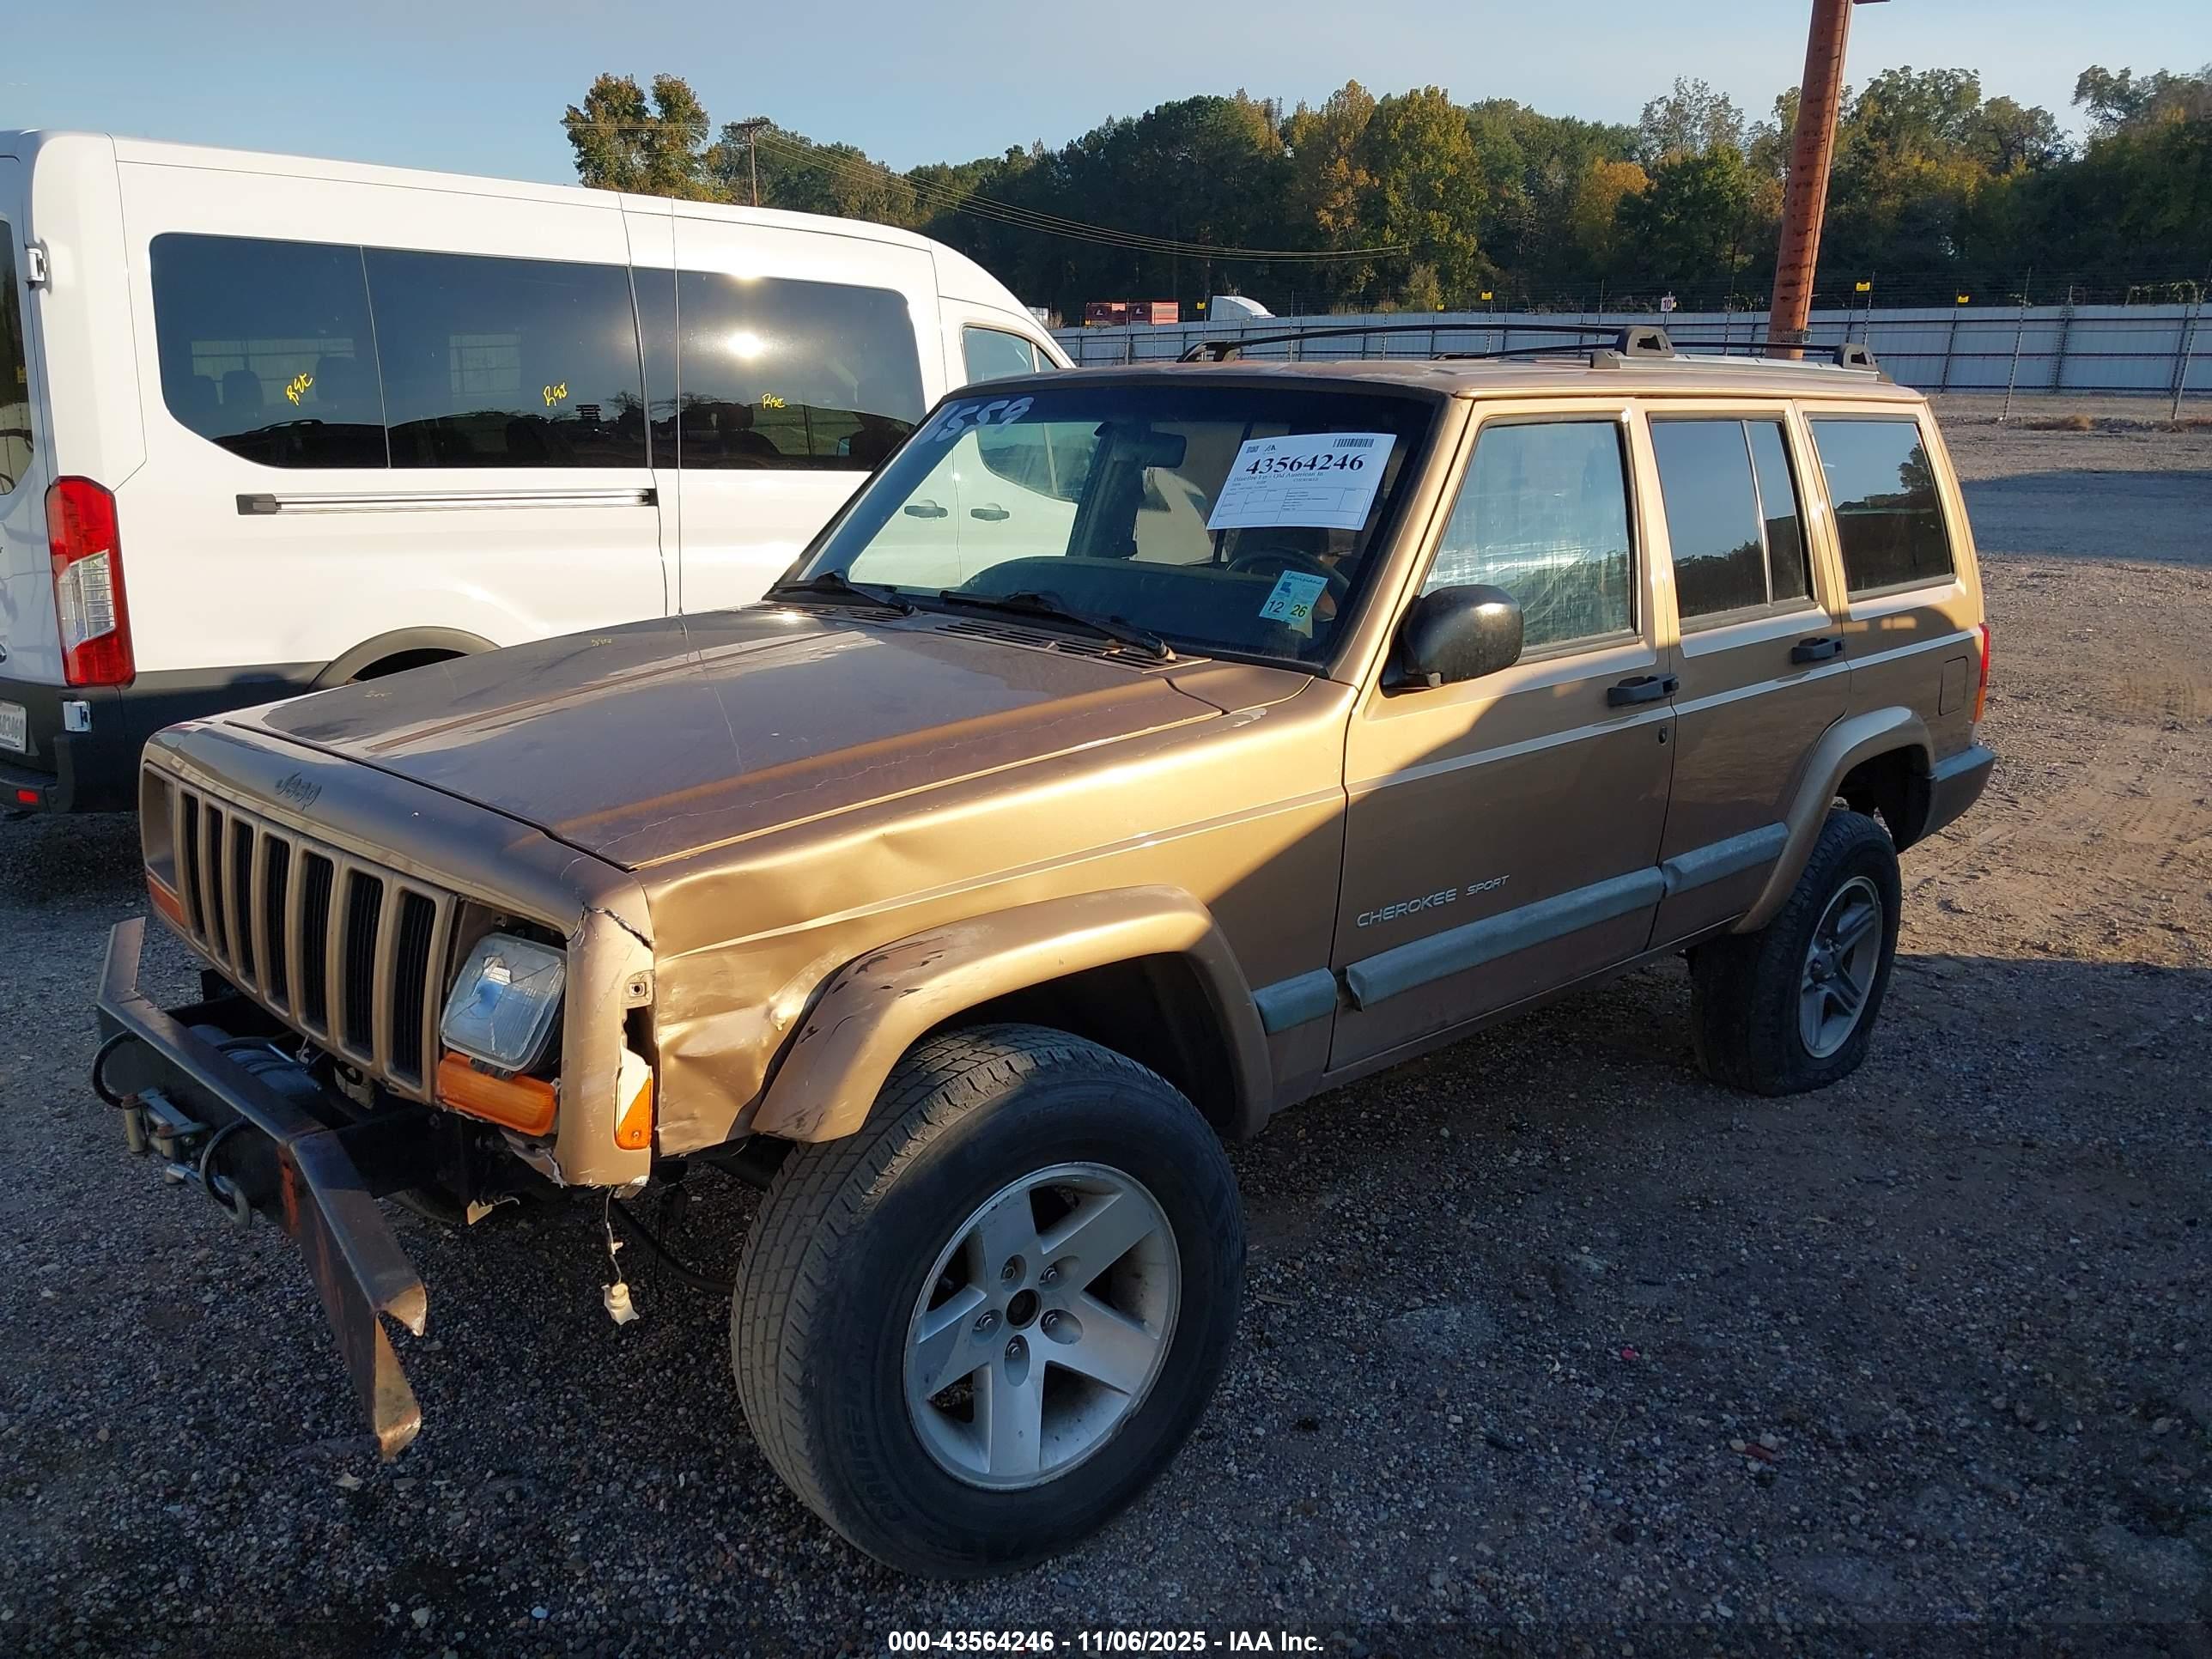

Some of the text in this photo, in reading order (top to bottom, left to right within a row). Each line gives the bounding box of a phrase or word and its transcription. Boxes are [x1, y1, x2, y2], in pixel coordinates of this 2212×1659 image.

[1245, 453, 1367, 474] 43564246
[1267, 599, 1309, 618] 12 26
[1357, 875, 1510, 927] CHEROKEE SPORT
